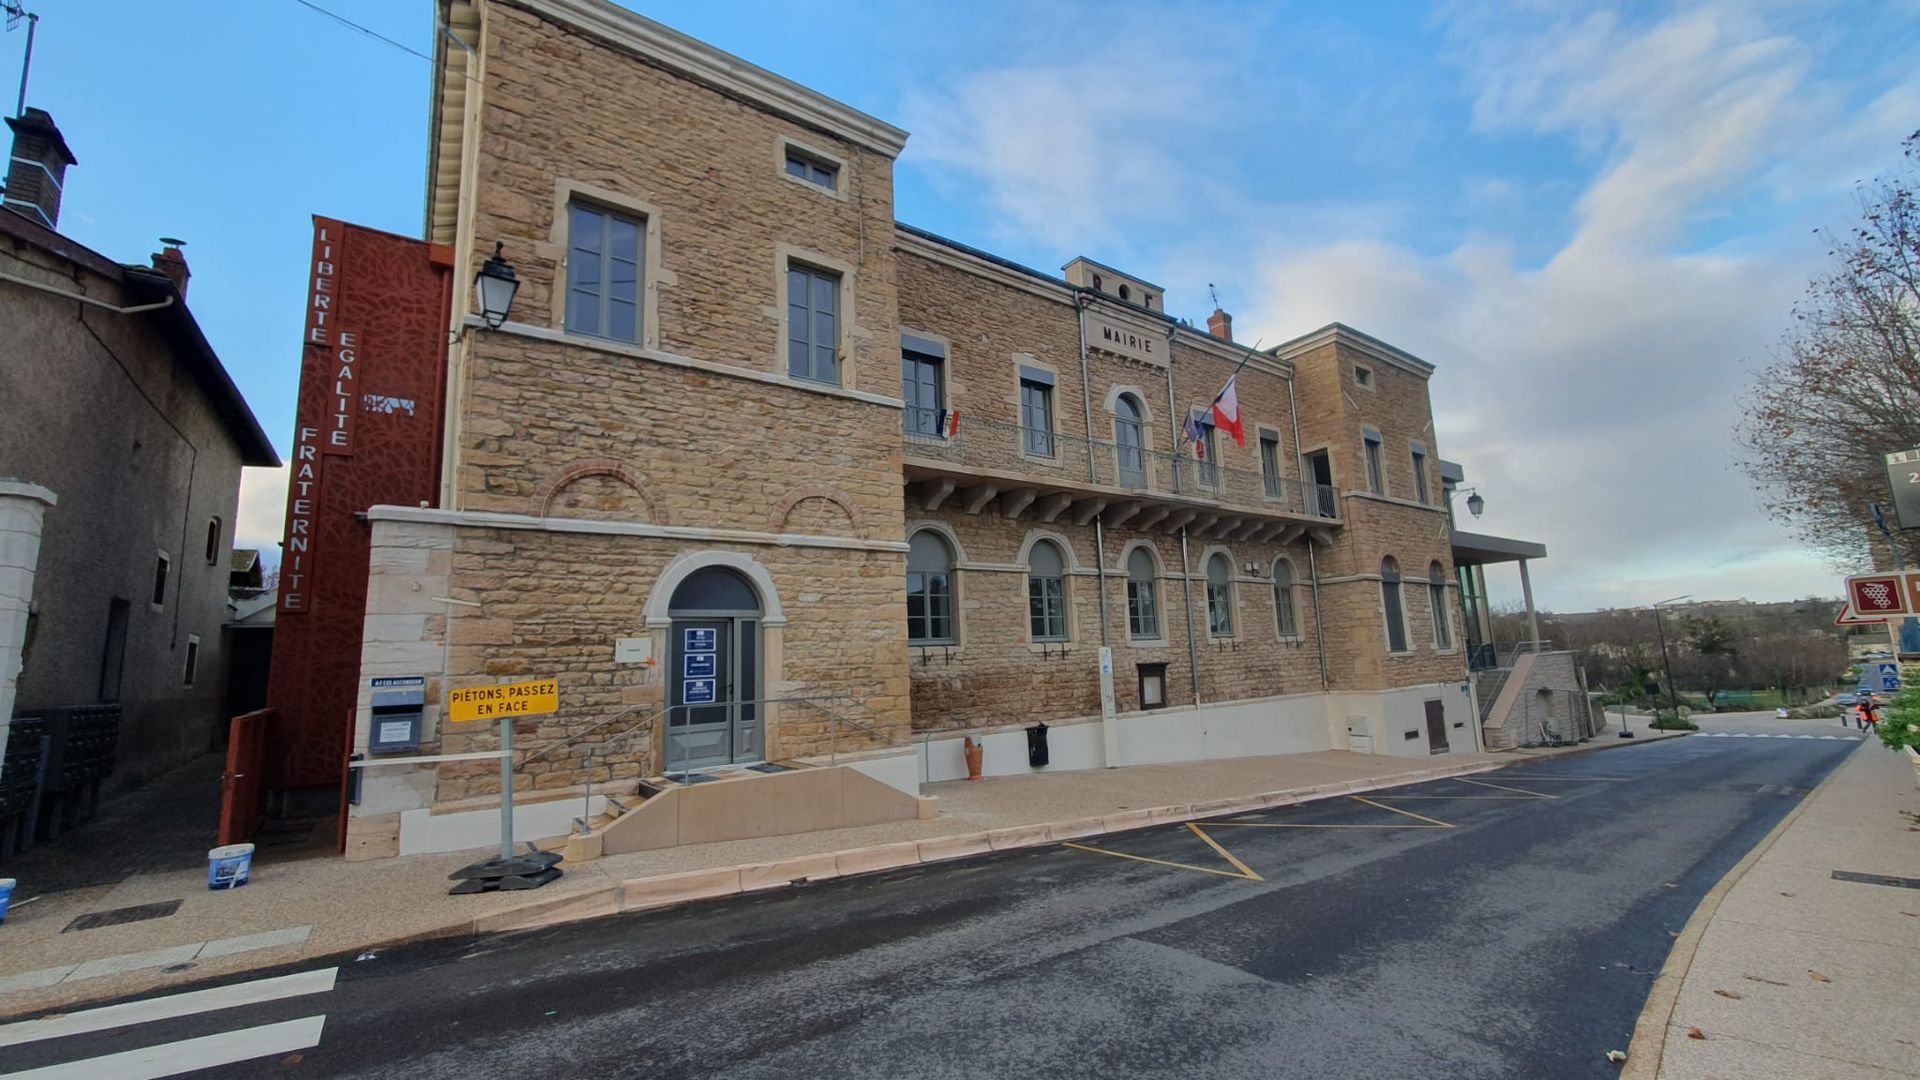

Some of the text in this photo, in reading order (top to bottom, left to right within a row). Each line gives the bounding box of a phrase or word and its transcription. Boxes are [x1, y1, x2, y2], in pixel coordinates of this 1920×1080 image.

[311, 228, 334, 343] LIBERTE
[1103, 326, 1152, 353] MAIRIE
[331, 332, 356, 446] EGALITE
[285, 427, 318, 609] FRATERNITE
[452, 684, 554, 703] PIÉTONS, PASSEZ
[477, 701, 528, 715] EN FACE
